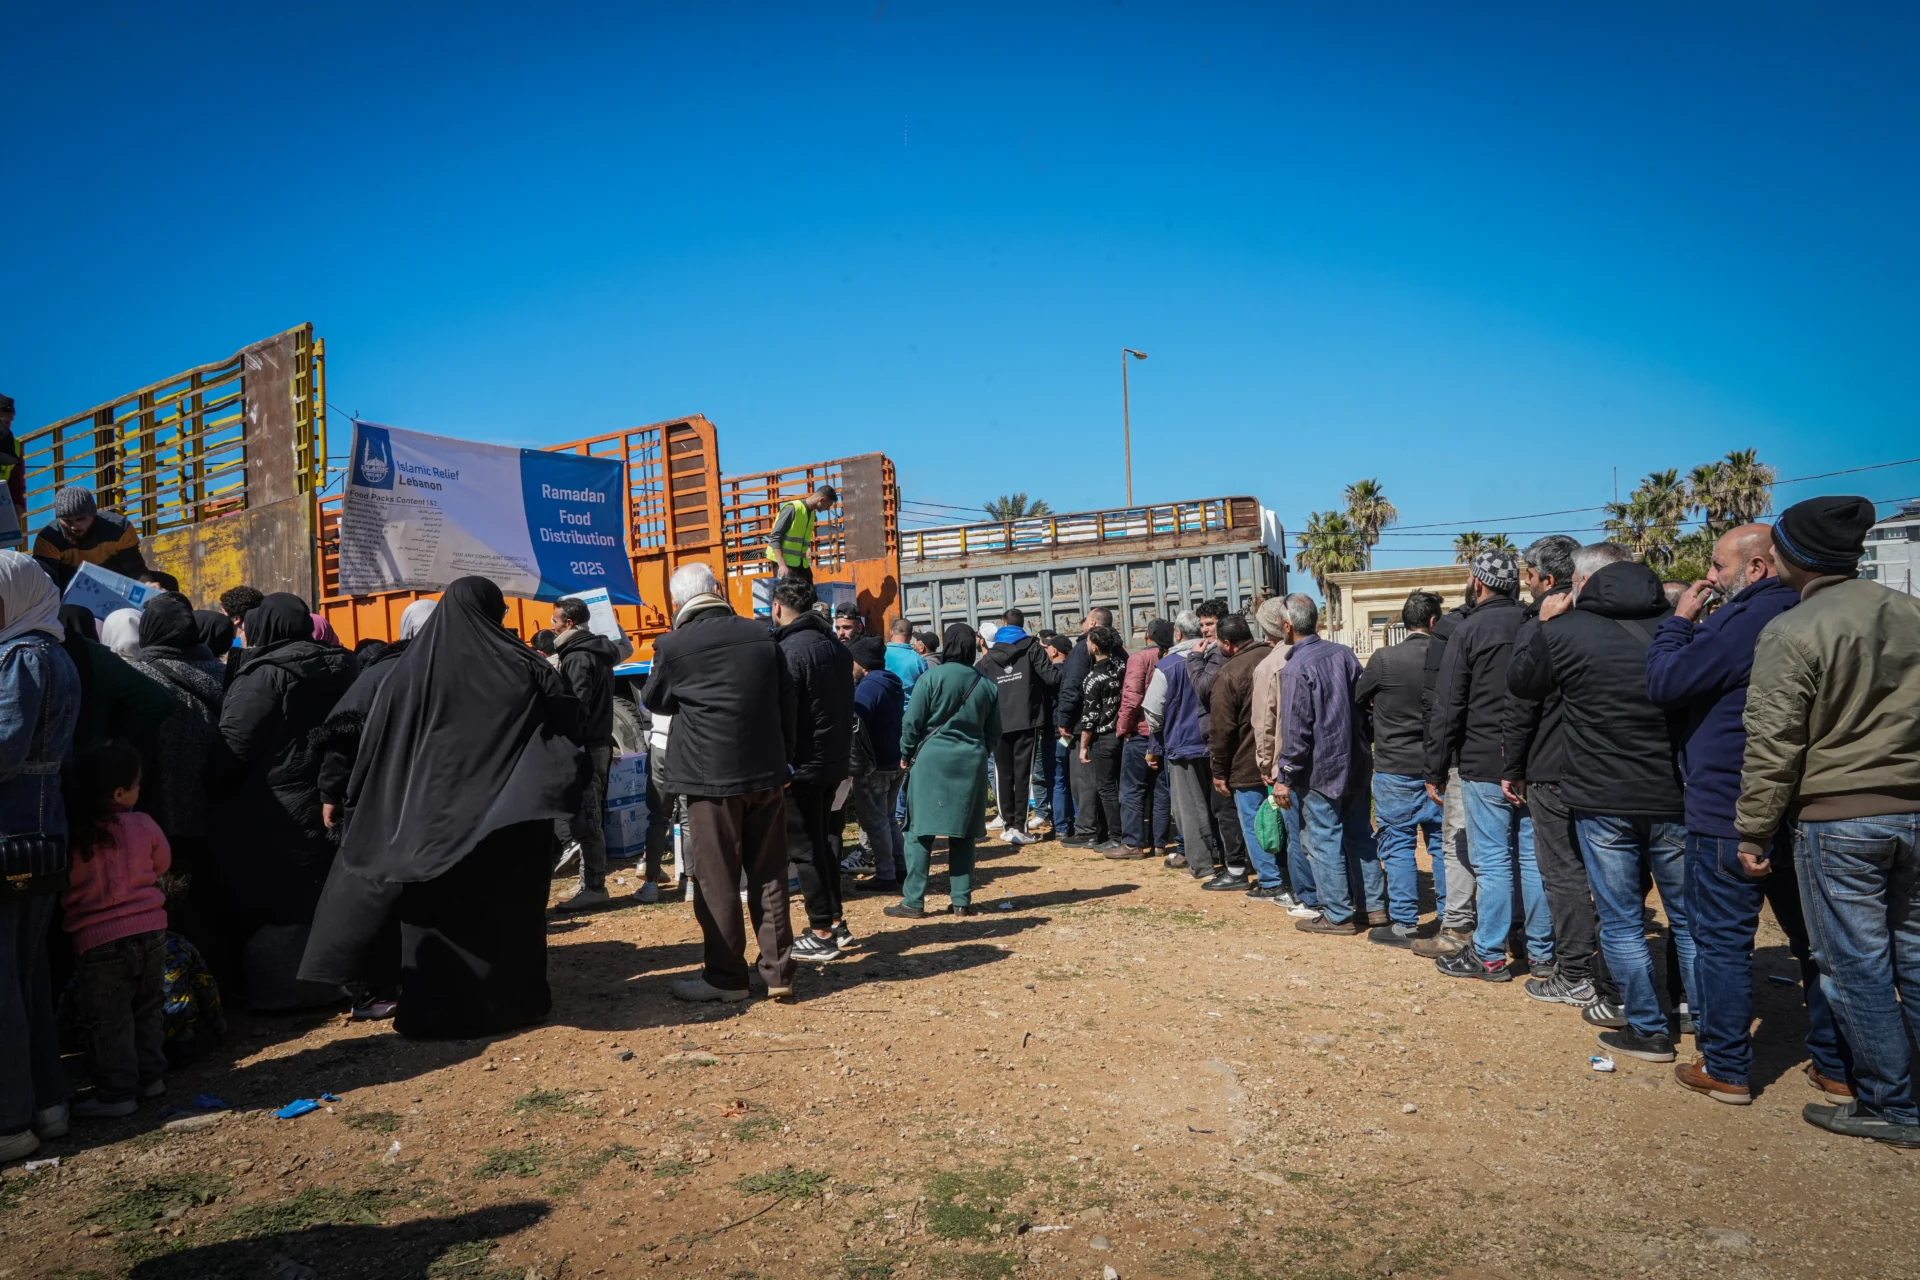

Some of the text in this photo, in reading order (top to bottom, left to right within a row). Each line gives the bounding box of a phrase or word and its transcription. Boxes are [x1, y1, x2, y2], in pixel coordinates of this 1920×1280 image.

[397, 460, 459, 480] Islamic Relief
[399, 474, 442, 491] Lebanon
[350, 490, 368, 500] Food
[371, 493, 394, 502] Packs
[396, 496, 424, 506] Content
[542, 484, 605, 503] Ramadan
[560, 510, 591, 526] Food
[540, 528, 615, 546] Distribution
[570, 561, 605, 575] 2025
